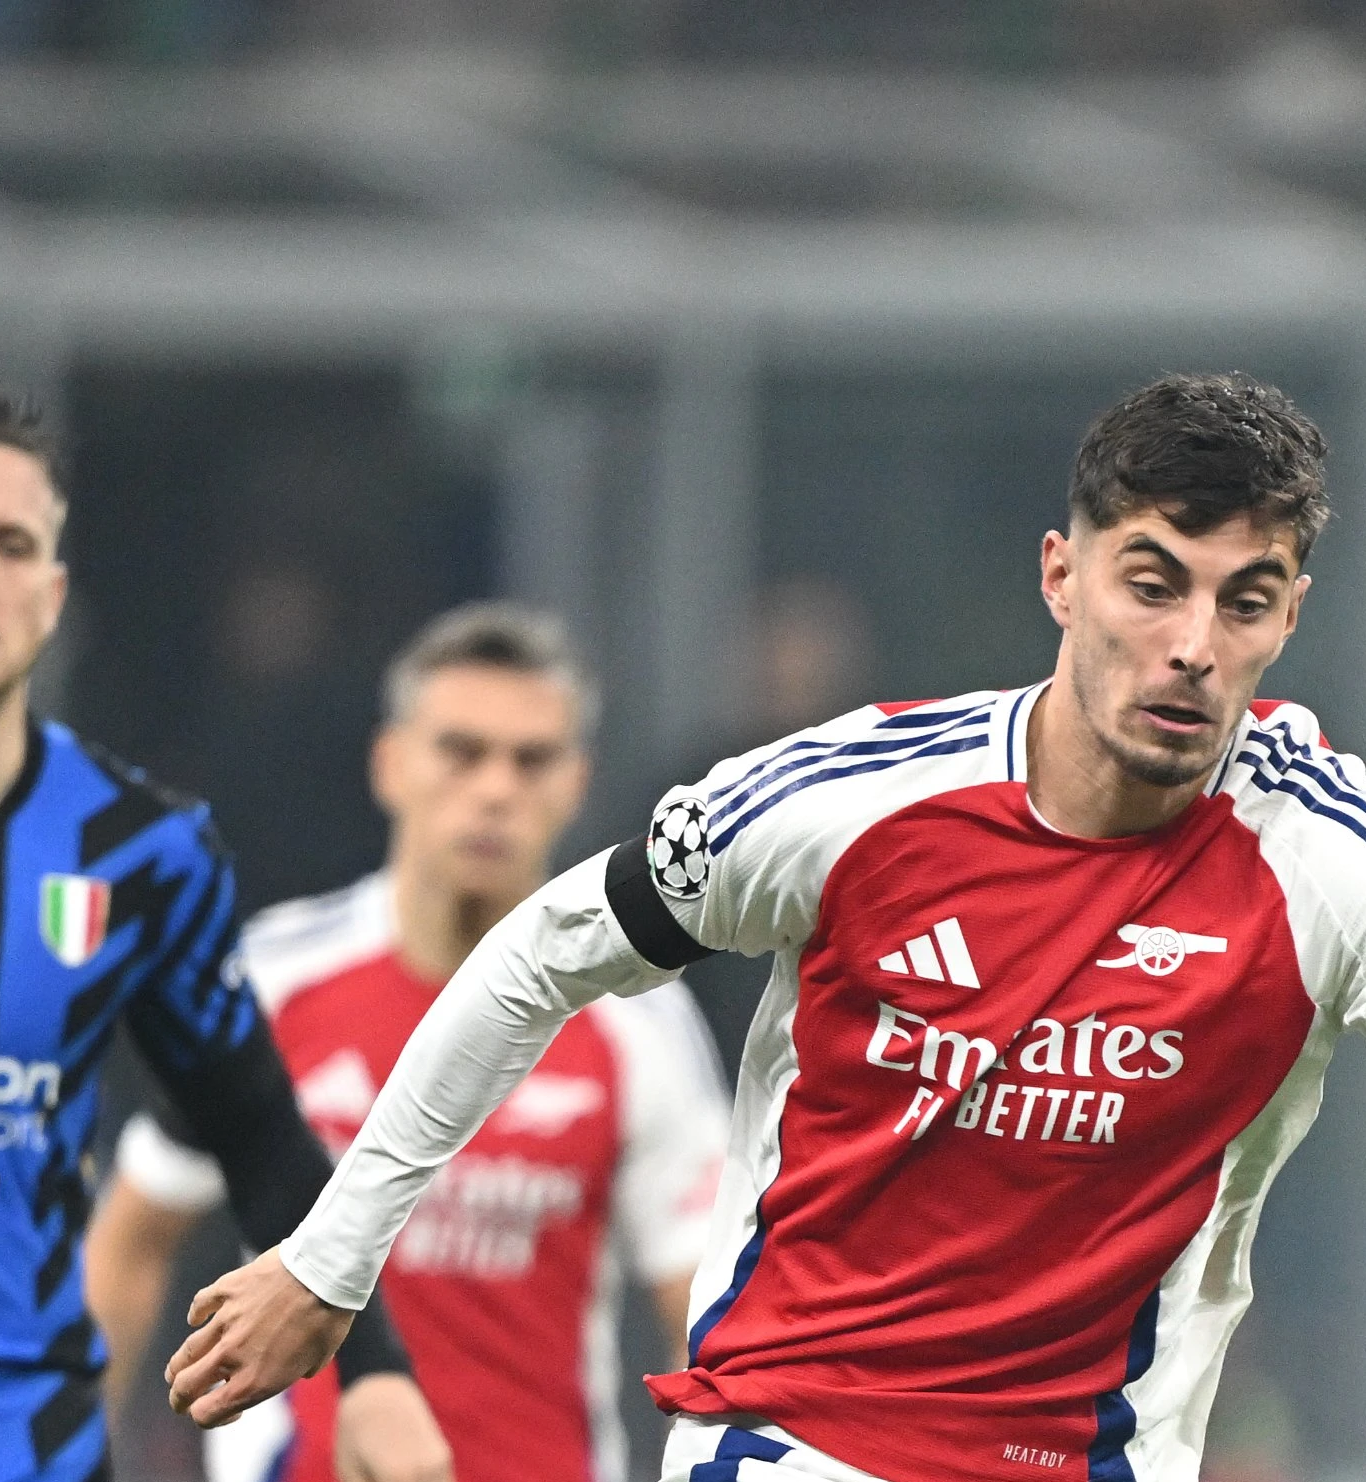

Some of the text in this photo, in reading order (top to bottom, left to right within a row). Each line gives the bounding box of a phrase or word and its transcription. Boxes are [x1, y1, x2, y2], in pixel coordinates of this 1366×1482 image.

[865, 999, 1185, 1092] Emates
[954, 1081, 1126, 1145] BETTER
[1002, 1443, 1067, 1469] HEAT.RDY
